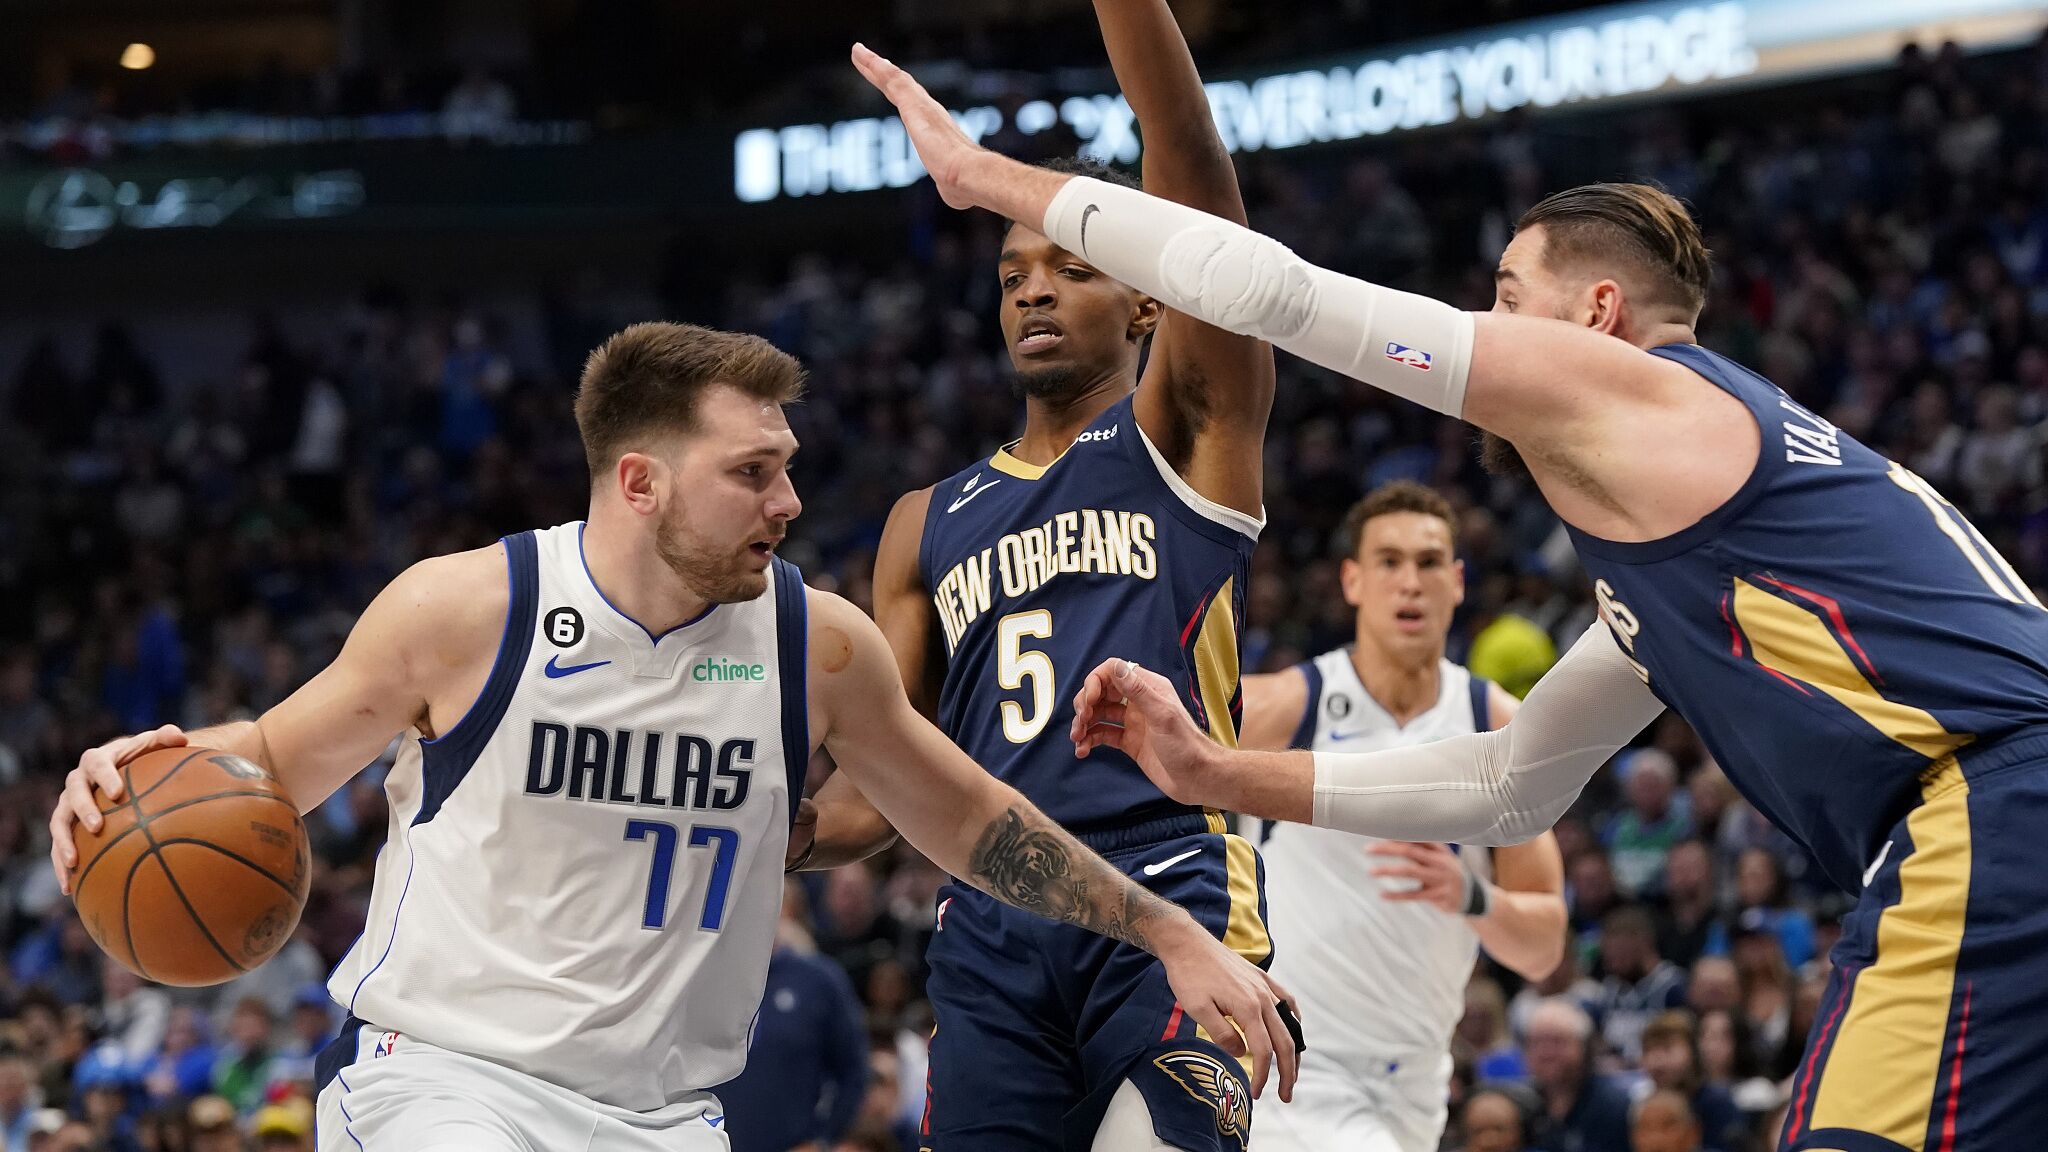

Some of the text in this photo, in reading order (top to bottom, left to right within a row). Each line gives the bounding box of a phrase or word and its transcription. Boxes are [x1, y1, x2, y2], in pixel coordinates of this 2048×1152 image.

[1203, 69, 1333, 155] EVER
[1453, 25, 1602, 118] YOUR
[552, 612, 576, 644] 6
[934, 509, 1158, 659] NEW ORLEANS
[692, 657, 765, 682] chime
[997, 608, 1056, 744] 5
[522, 718, 758, 812] DALLAS
[622, 817, 742, 934] 77
